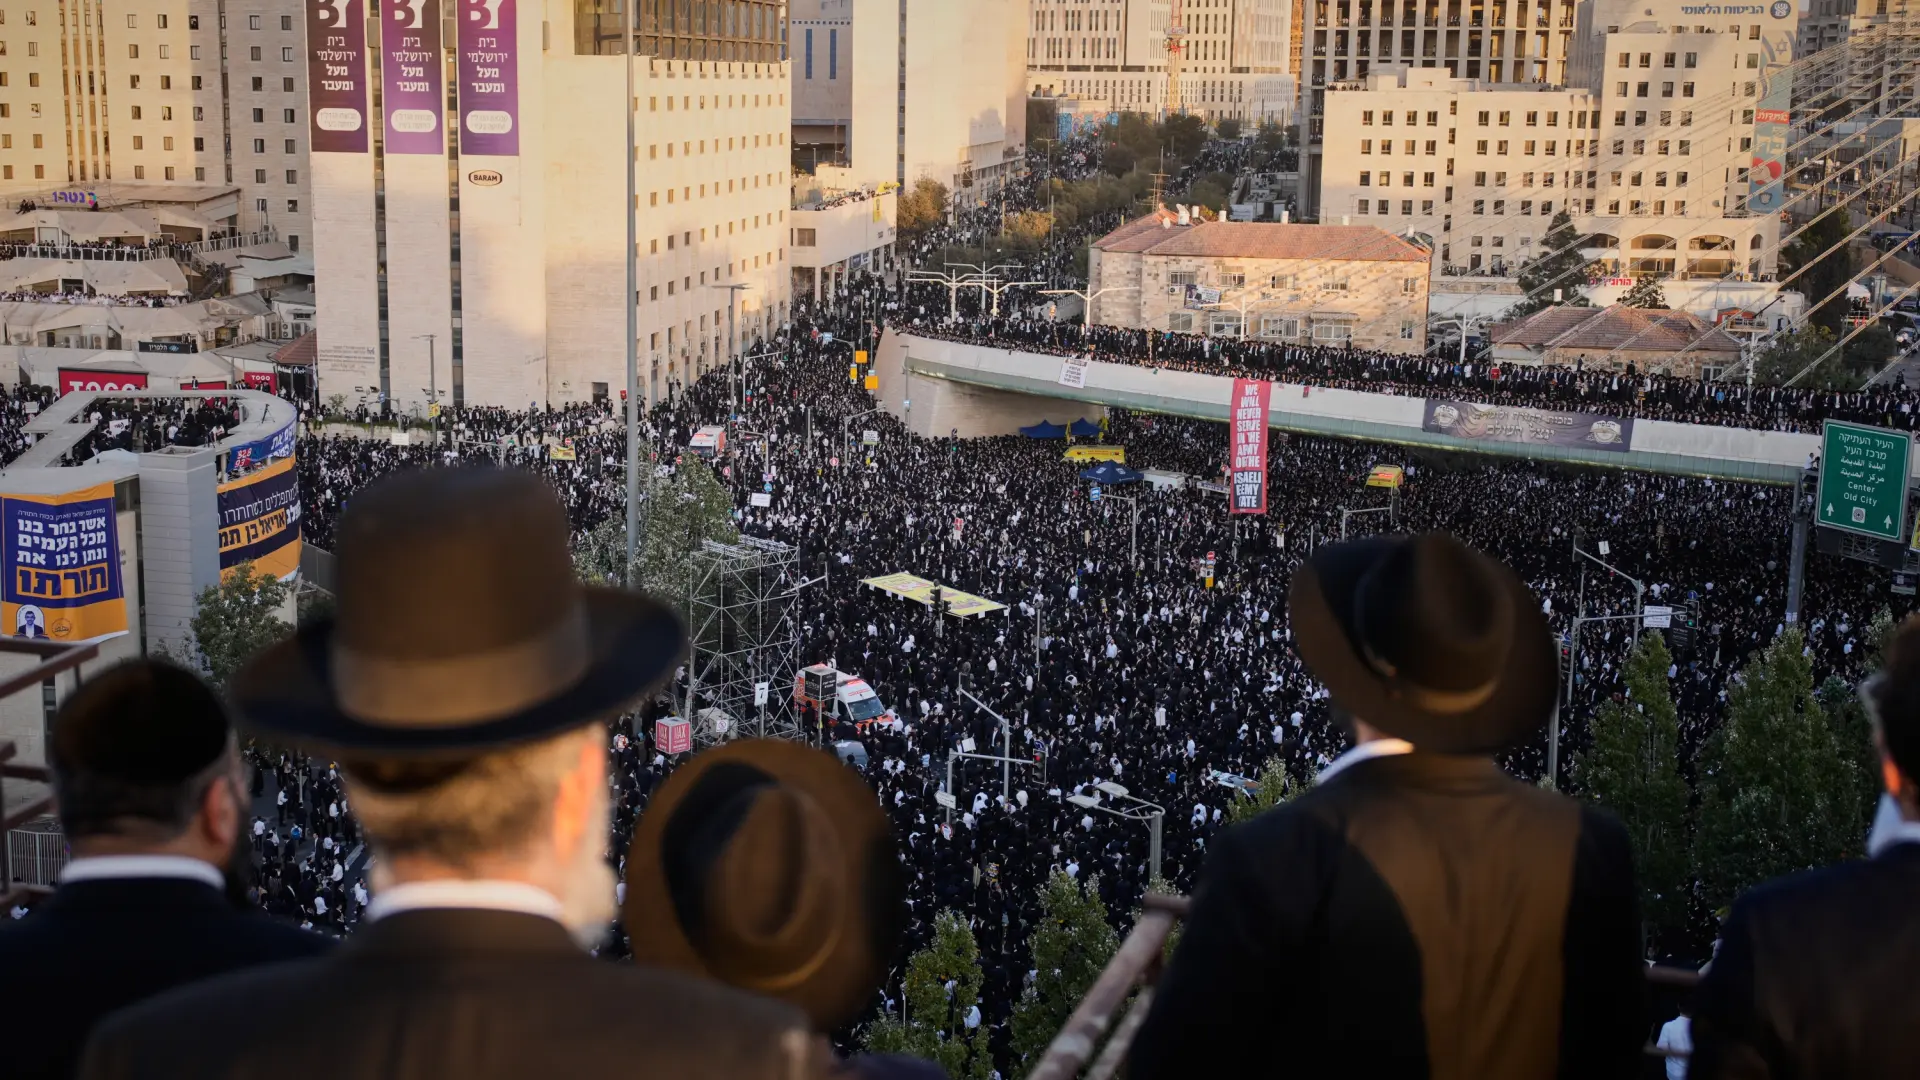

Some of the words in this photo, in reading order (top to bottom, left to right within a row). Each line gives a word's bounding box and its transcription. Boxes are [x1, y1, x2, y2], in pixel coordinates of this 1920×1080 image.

[1681, 3, 1721, 15] הלאומי
[1723, 5, 1764, 15] הביטוח
[327, 36, 345, 46] בית
[402, 37, 421, 48] בית
[478, 37, 497, 48] בית
[316, 49, 356, 61] ירושלמי
[392, 50, 432, 63] ירושלמי
[467, 51, 508, 63] ירושלמי
[326, 63, 348, 76] מעל
[401, 65, 424, 77] מעל
[476, 66, 499, 78] מעל
[321, 80, 354, 91] ומעבר
[396, 81, 429, 92] ומעבר
[472, 82, 505, 93] ומעבר
[474, 174, 498, 182] BARAM
[1245, 384, 1259, 396] WE
[1241, 396, 1260, 408] WILL
[1236, 407, 1261, 420] NEVER
[1838, 432, 1871, 446] העתיקה
[1875, 439, 1894, 450] העיר
[1843, 444, 1864, 456] העיר
[1866, 448, 1887, 460] מרכז
[1246, 456, 1260, 467] HE
[1840, 468, 1864, 479] المدينة
[1867, 473, 1885, 484] مركز
[1848, 481, 1876, 493] Center
[1843, 492, 1858, 502] Old
[1860, 495, 1878, 507] City
[17, 518, 44, 534] בנו
[78, 516, 106, 531] אשר
[259, 511, 286, 536] אריאל
[80, 531, 107, 547] מכל
[219, 528, 241, 548] תמ
[245, 523, 259, 544] בן
[18, 532, 78, 552] העמים
[17, 550, 47, 566] את
[55, 551, 78, 567] לנו
[82, 547, 107, 565] ונתן
[18, 566, 107, 596] תורתו
[759, 687, 765, 699] 7
